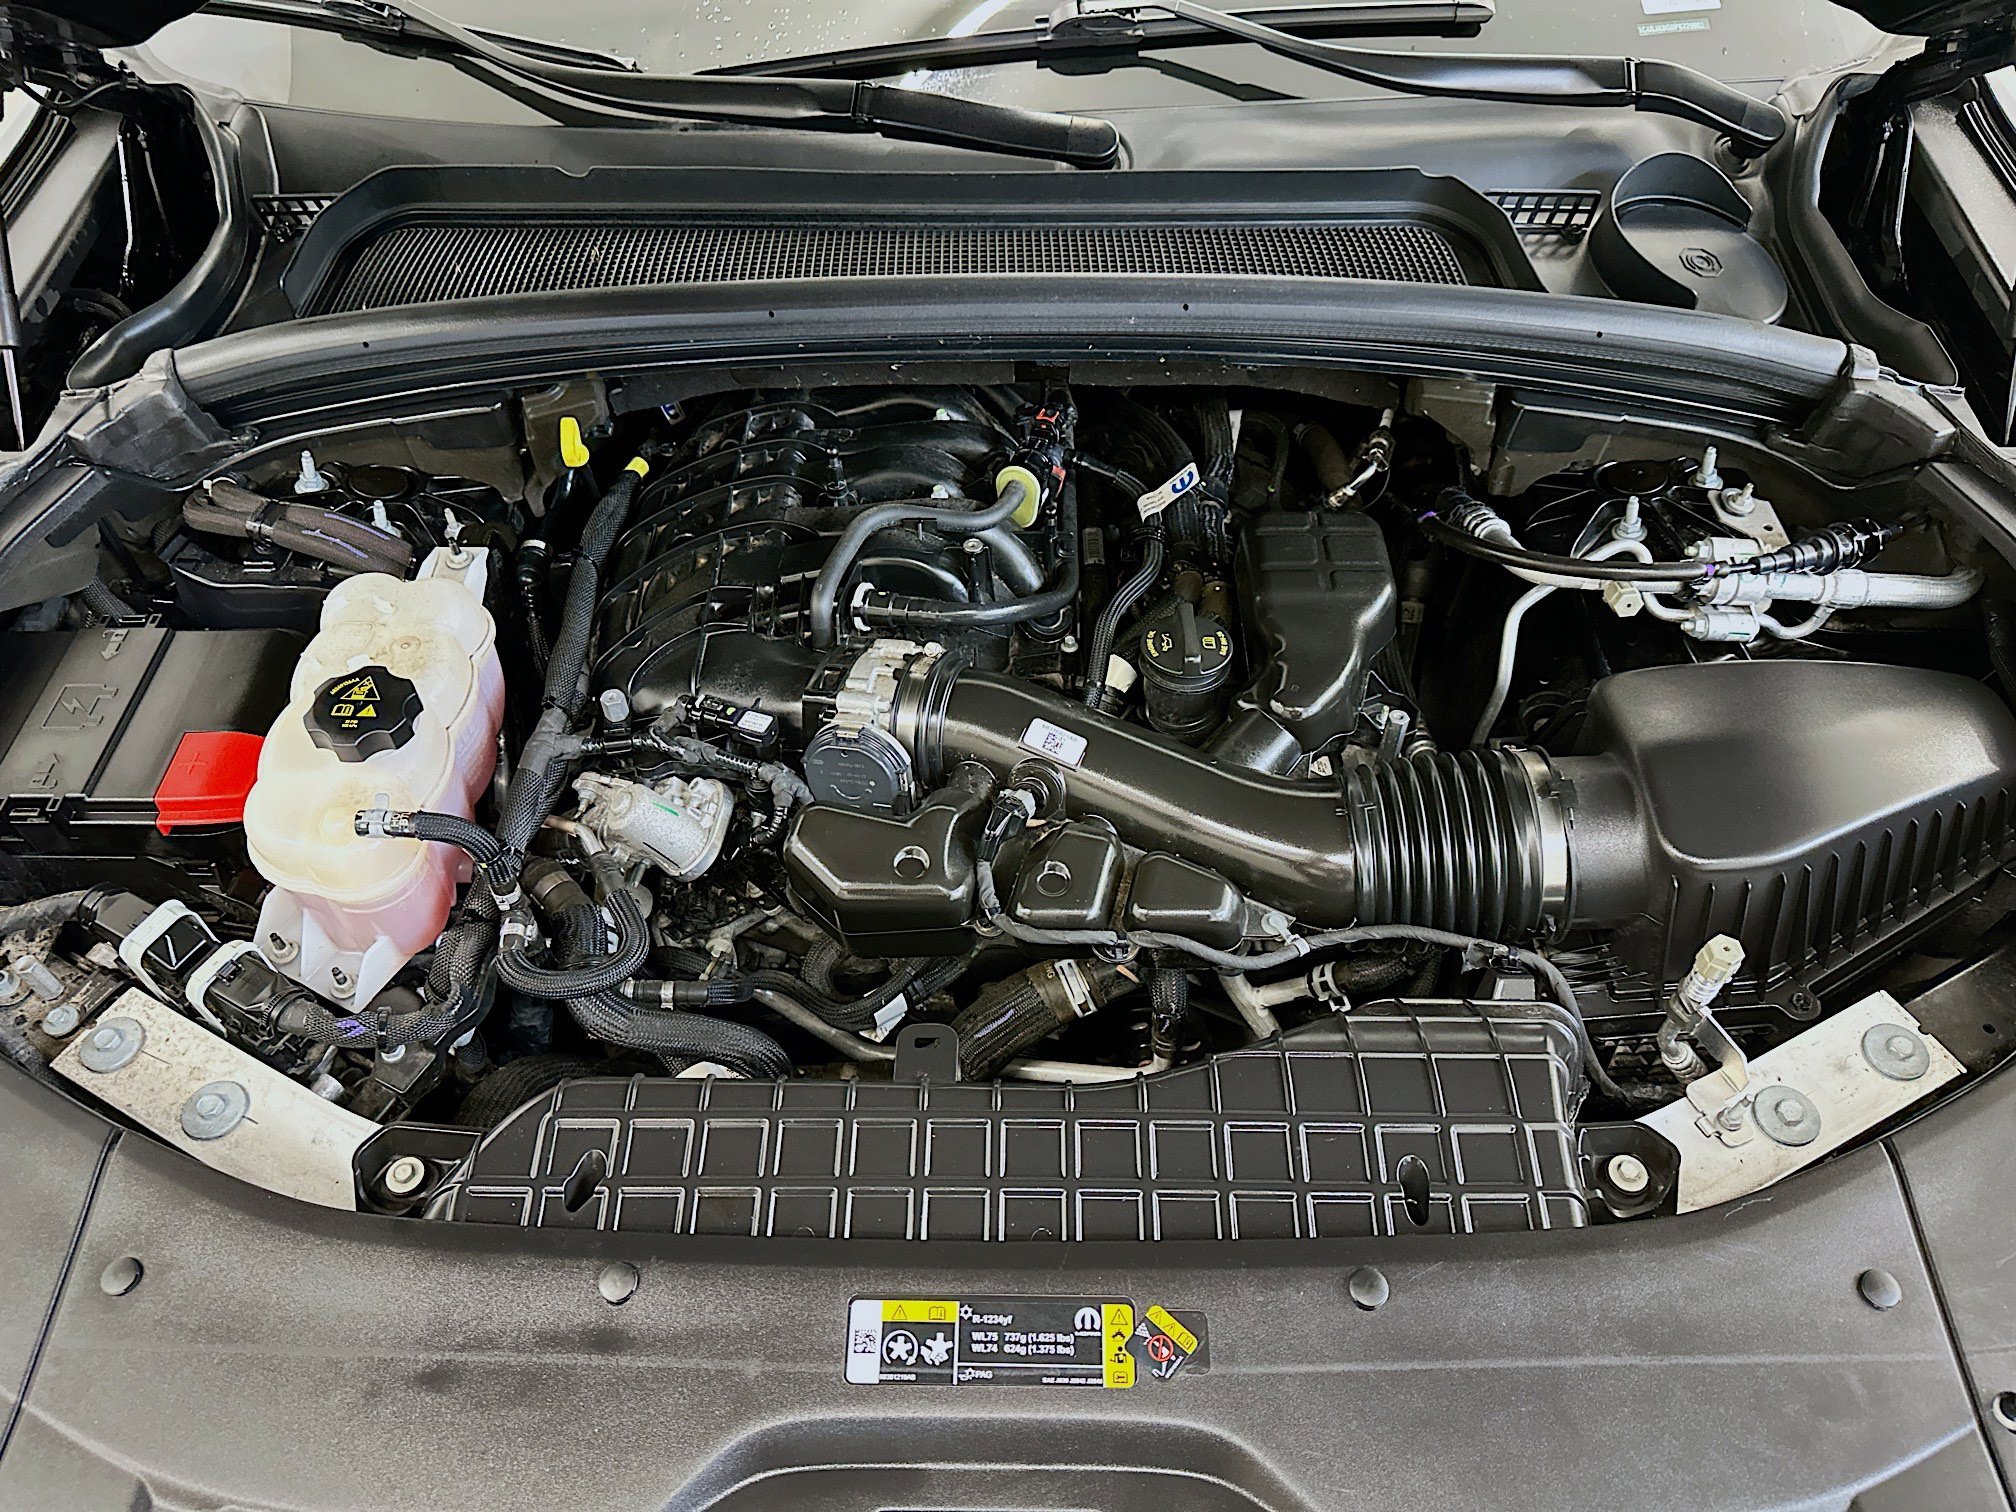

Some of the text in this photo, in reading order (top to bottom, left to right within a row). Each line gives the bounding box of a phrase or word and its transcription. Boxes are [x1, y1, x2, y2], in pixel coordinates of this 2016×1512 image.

[973, 1314, 1013, 1326] R-1234yf
[971, 1331, 999, 1341] WL75
[1003, 1332, 1027, 1344] 737g
[1056, 1333, 1075, 1345] lbs)
[971, 1343, 1075, 1357] WL74 624g (1.375 lbs)
[974, 1370, 994, 1379] PAG
